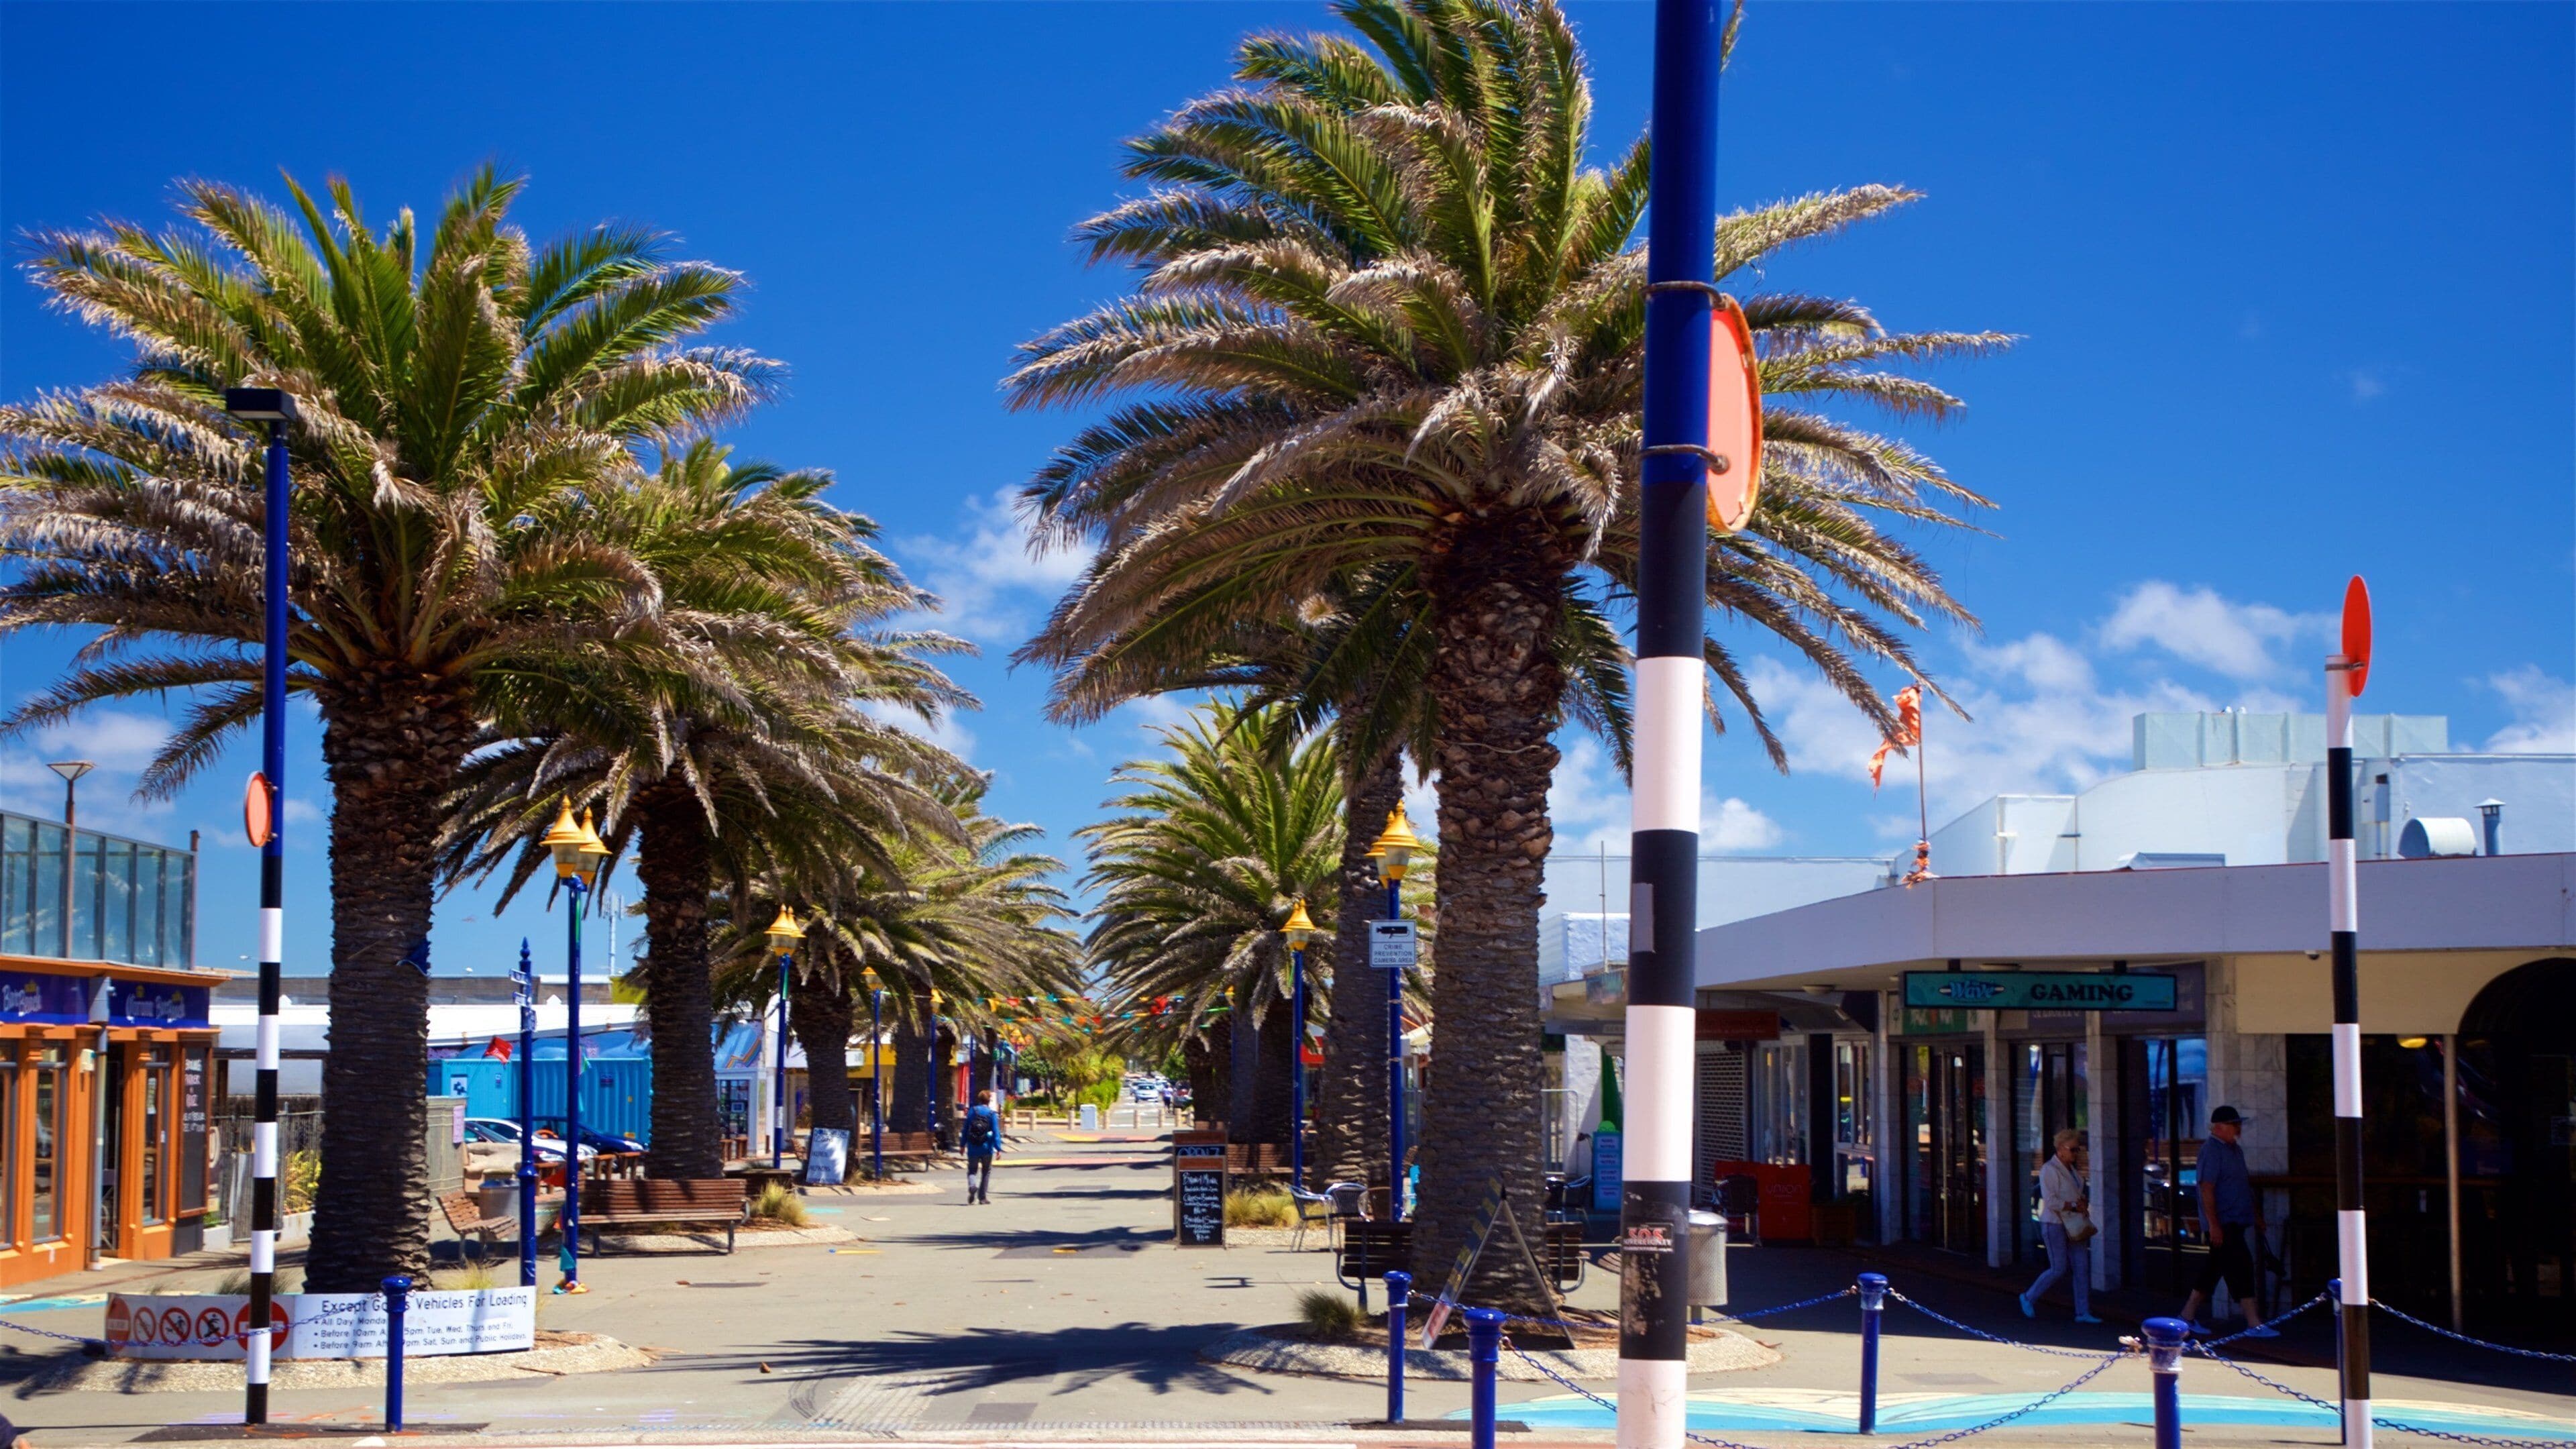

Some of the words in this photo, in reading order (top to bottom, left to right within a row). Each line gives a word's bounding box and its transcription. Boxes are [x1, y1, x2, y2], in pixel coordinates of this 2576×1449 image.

[2030, 983, 2135, 1002] GAMING
[1627, 1227, 1665, 1241] SOS
[321, 1300, 367, 1314] Except
[372, 1299, 411, 1311] Gos
[416, 1297, 464, 1309] Vehicles
[468, 1296, 485, 1307] For
[490, 1294, 527, 1307] Loading
[337, 1318, 353, 1327] Day
[358, 1317, 387, 1326] Monda
[353, 1328, 376, 1337] 10am
[352, 1340, 372, 1348] 9am
[441, 1337, 456, 1345] Sun
[476, 1335, 496, 1344] Public
